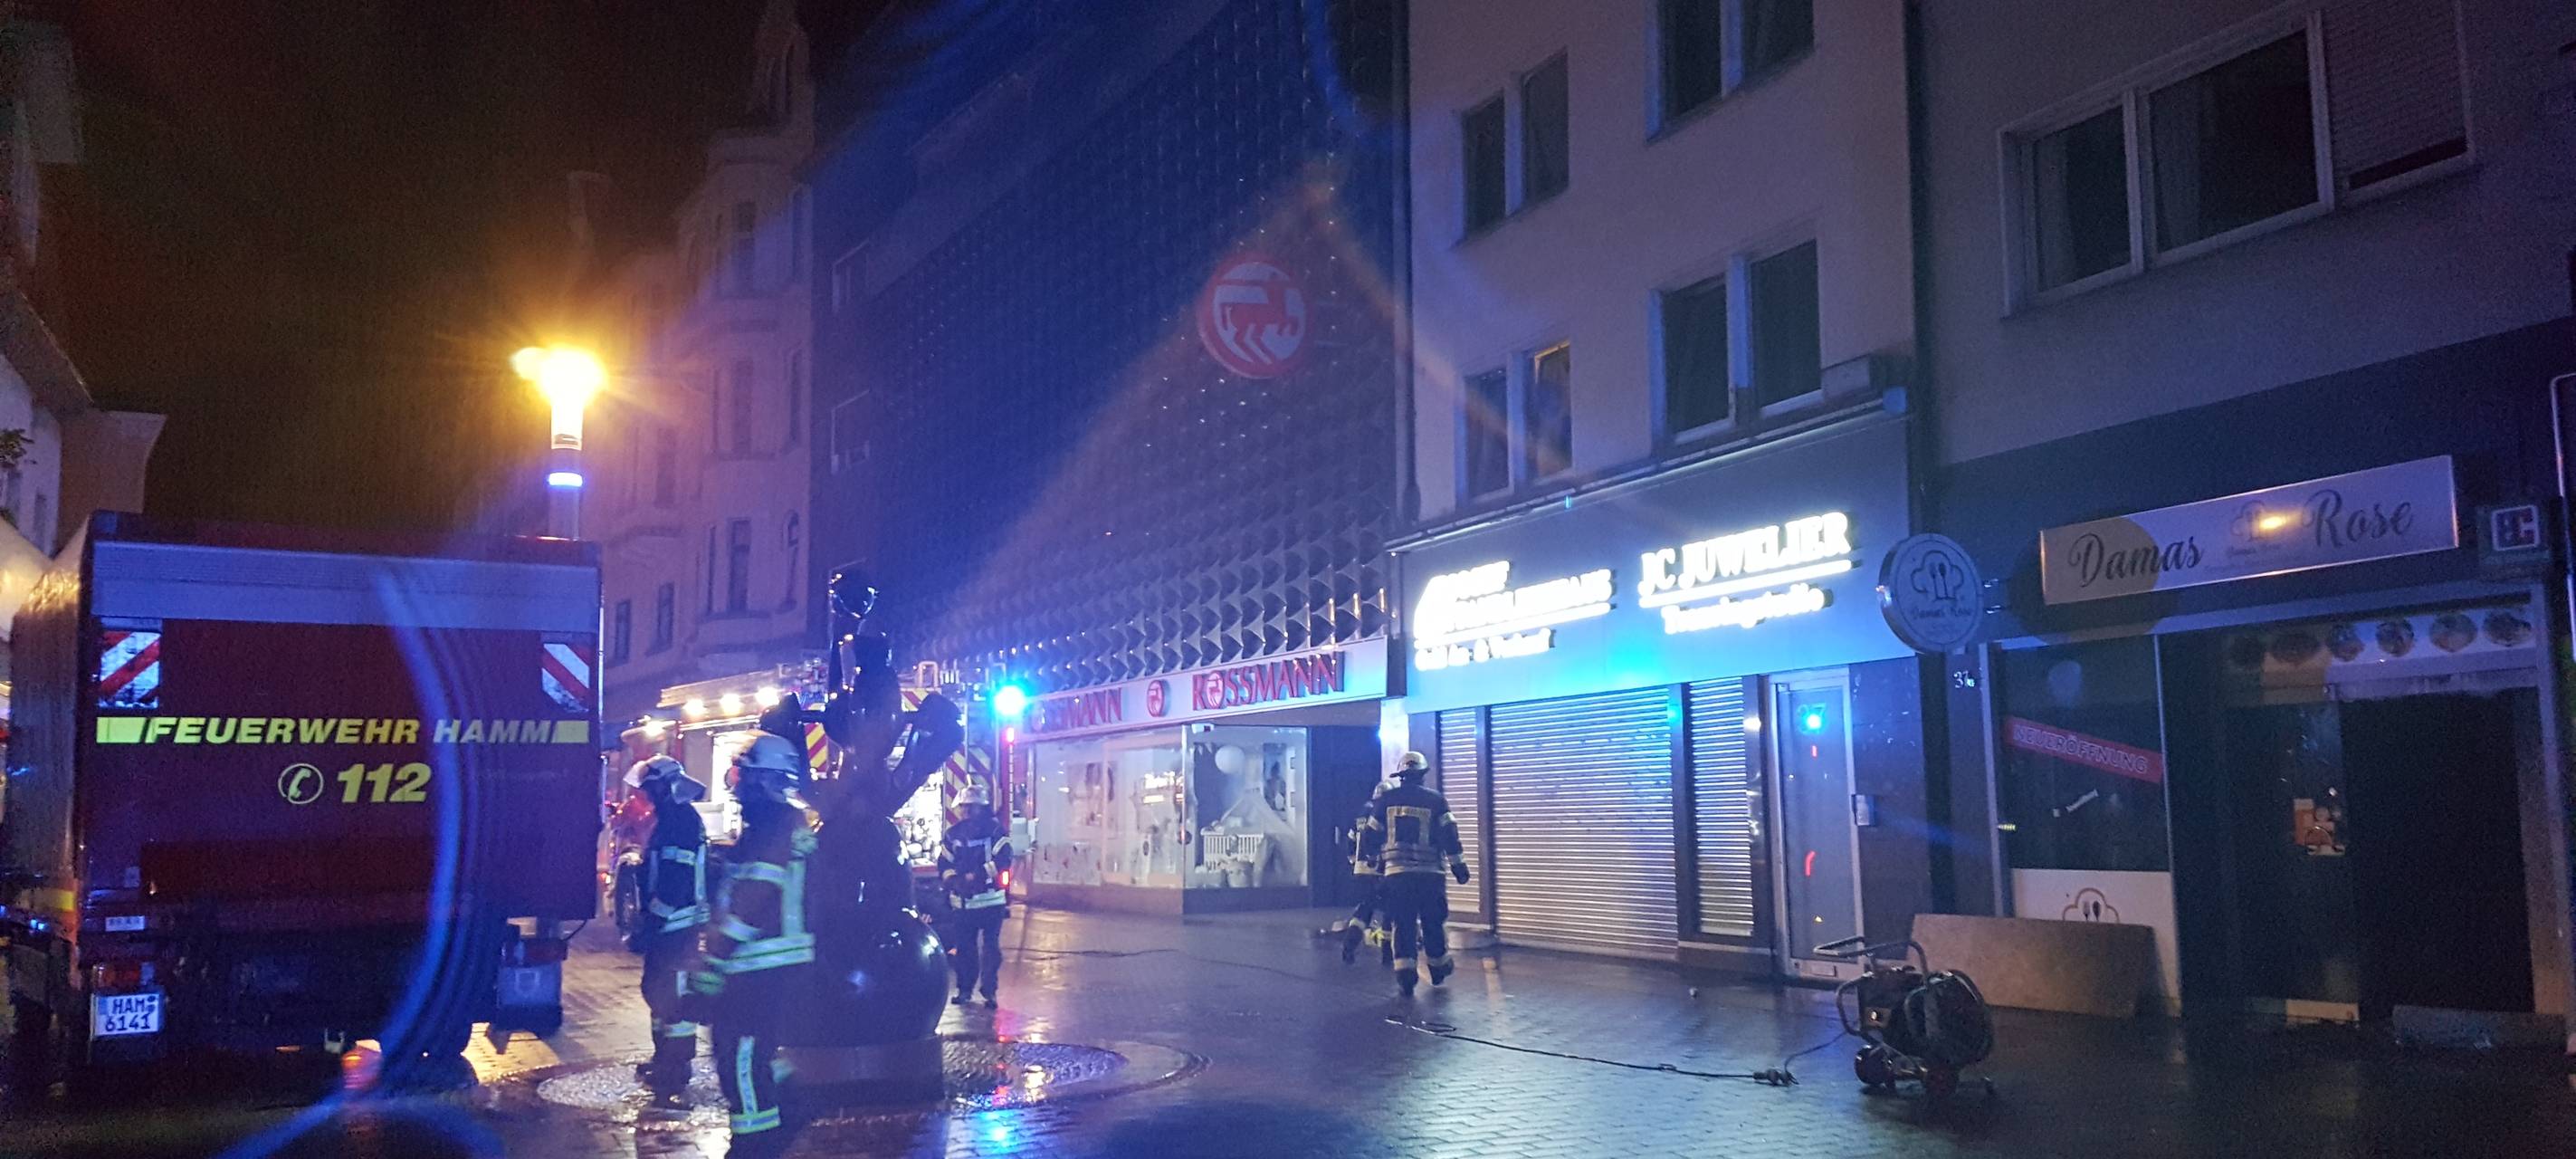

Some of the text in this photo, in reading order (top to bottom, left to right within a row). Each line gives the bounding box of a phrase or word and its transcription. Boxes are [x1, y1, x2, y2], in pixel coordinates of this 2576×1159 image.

[1637, 512, 1852, 597] JC JUWELIER
[2067, 489, 2414, 589] Damas Rose
[1192, 651, 1345, 711] ROSSMANN
[145, 716, 551, 744] FEUERWEHR HAMM
[2012, 723, 2150, 775] NEUERÖFFNUNG
[337, 762, 433, 804] 112
[105, 1011, 151, 1032] 6141
[111, 997, 148, 1015] HAM
